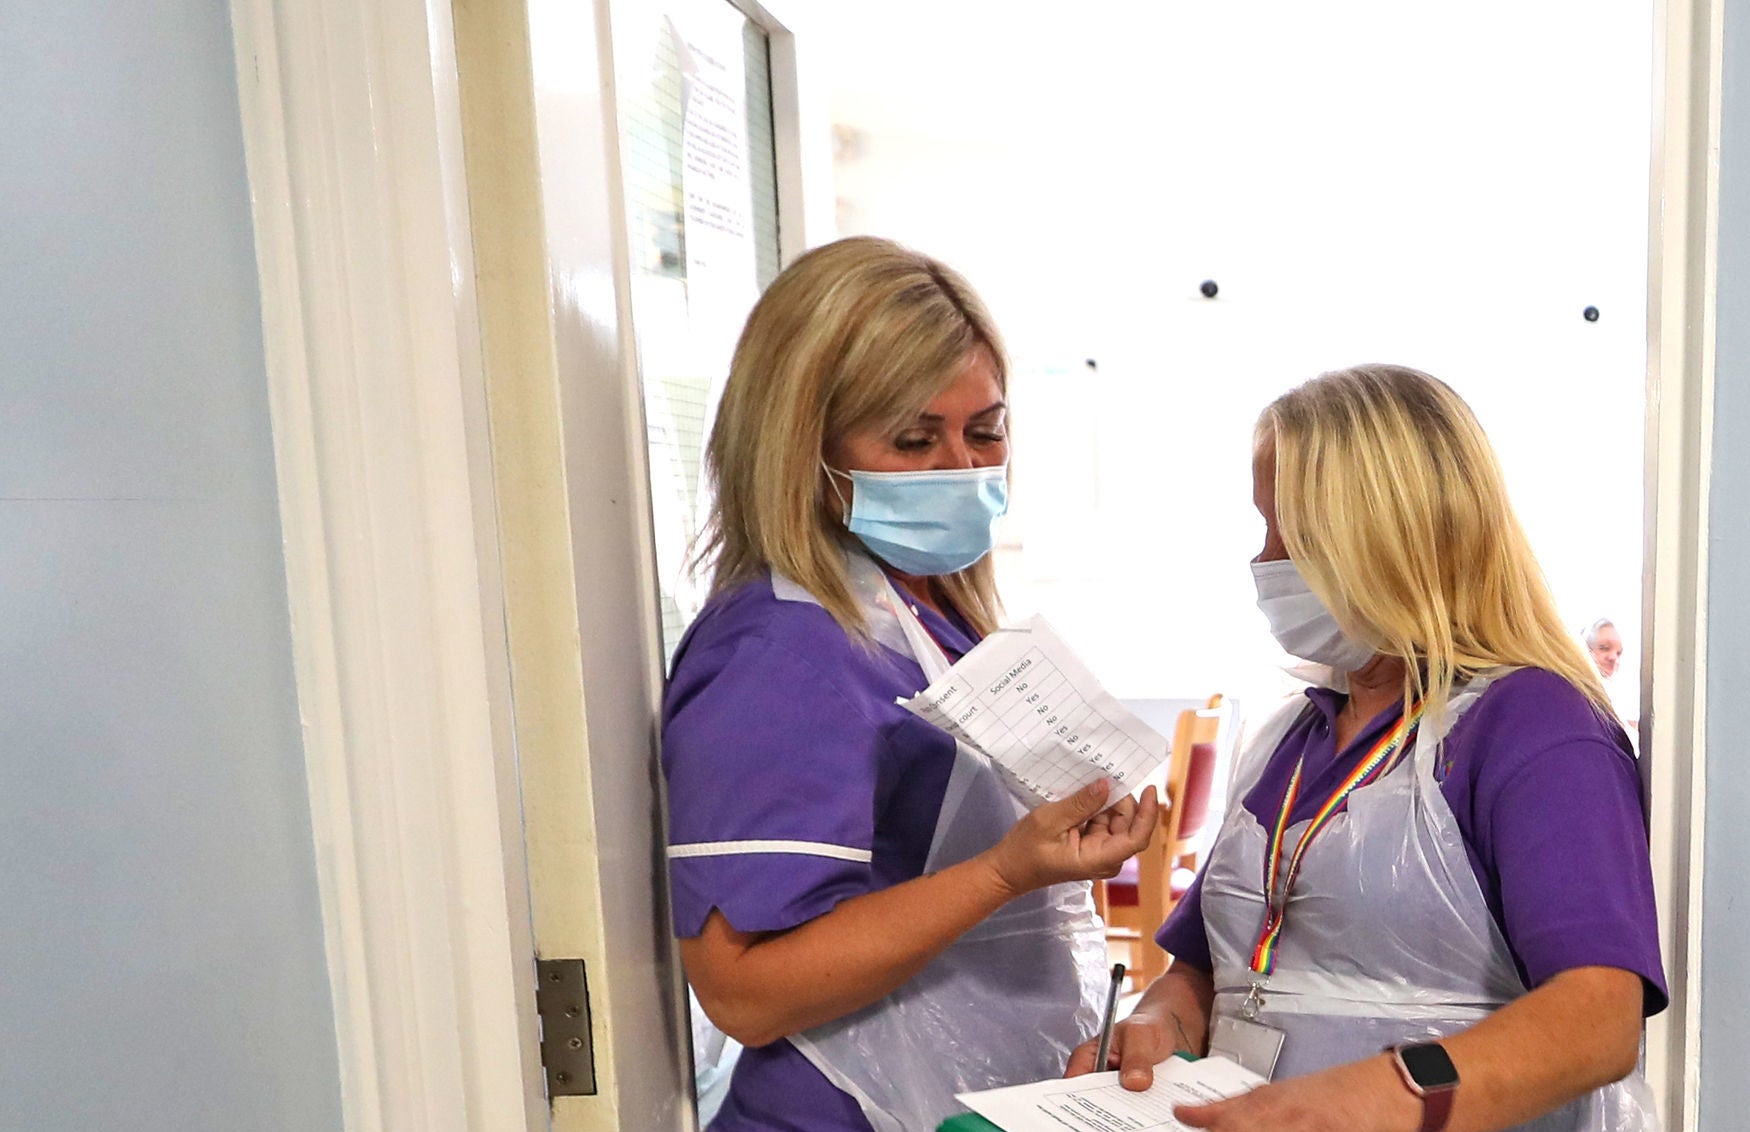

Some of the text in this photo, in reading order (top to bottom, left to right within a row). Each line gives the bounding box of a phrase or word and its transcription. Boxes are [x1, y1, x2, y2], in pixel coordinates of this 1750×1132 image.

[990, 659, 1032, 695] Social Media
[1016, 682, 1028, 693] No
[1025, 693, 1039, 704] Yes
[959, 706, 978, 723] court
[1037, 704, 1049, 715] No
[1046, 715, 1058, 726] No
[1054, 725, 1068, 737] Yes
[1067, 734, 1079, 745] No
[1077, 743, 1091, 755] Yes
[1089, 753, 1103, 764] Yes
[1113, 771, 1125, 782] No
